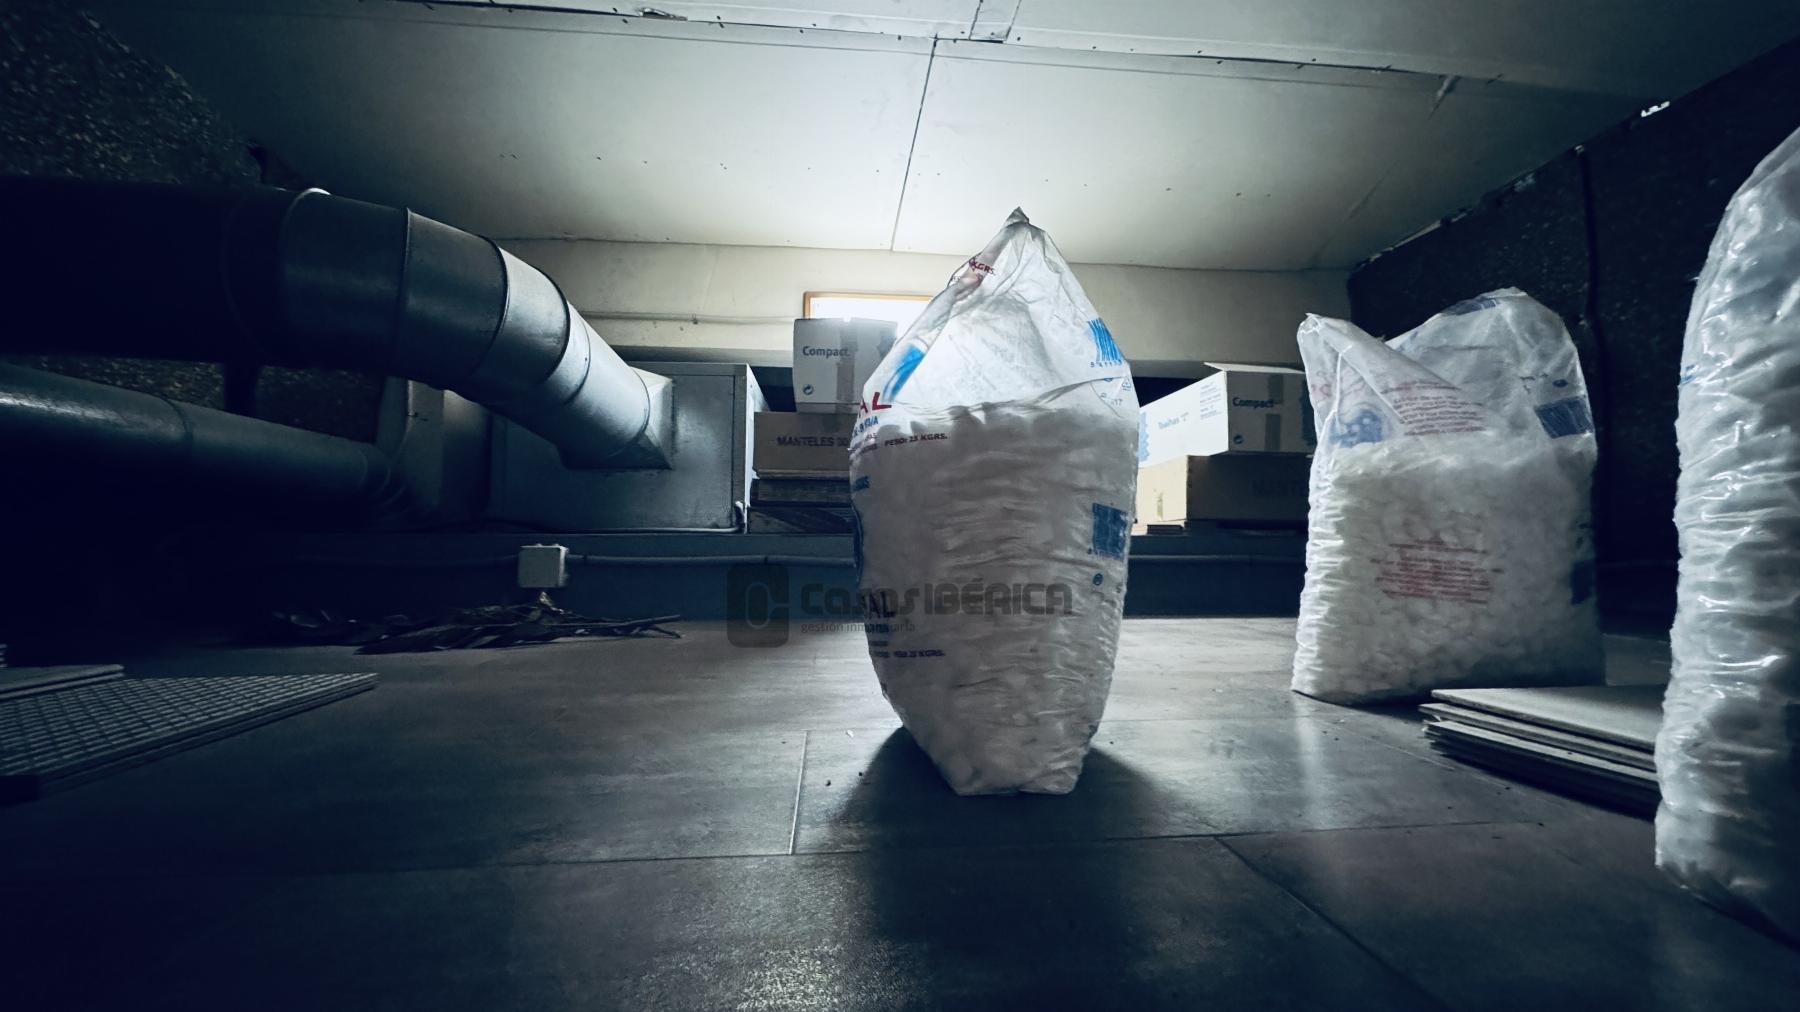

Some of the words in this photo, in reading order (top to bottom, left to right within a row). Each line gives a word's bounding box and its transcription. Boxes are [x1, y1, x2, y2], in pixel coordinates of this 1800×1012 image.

[802, 345, 850, 359] Compact
[1232, 397, 1274, 410] Compact
[776, 435, 834, 447] MANTELES
